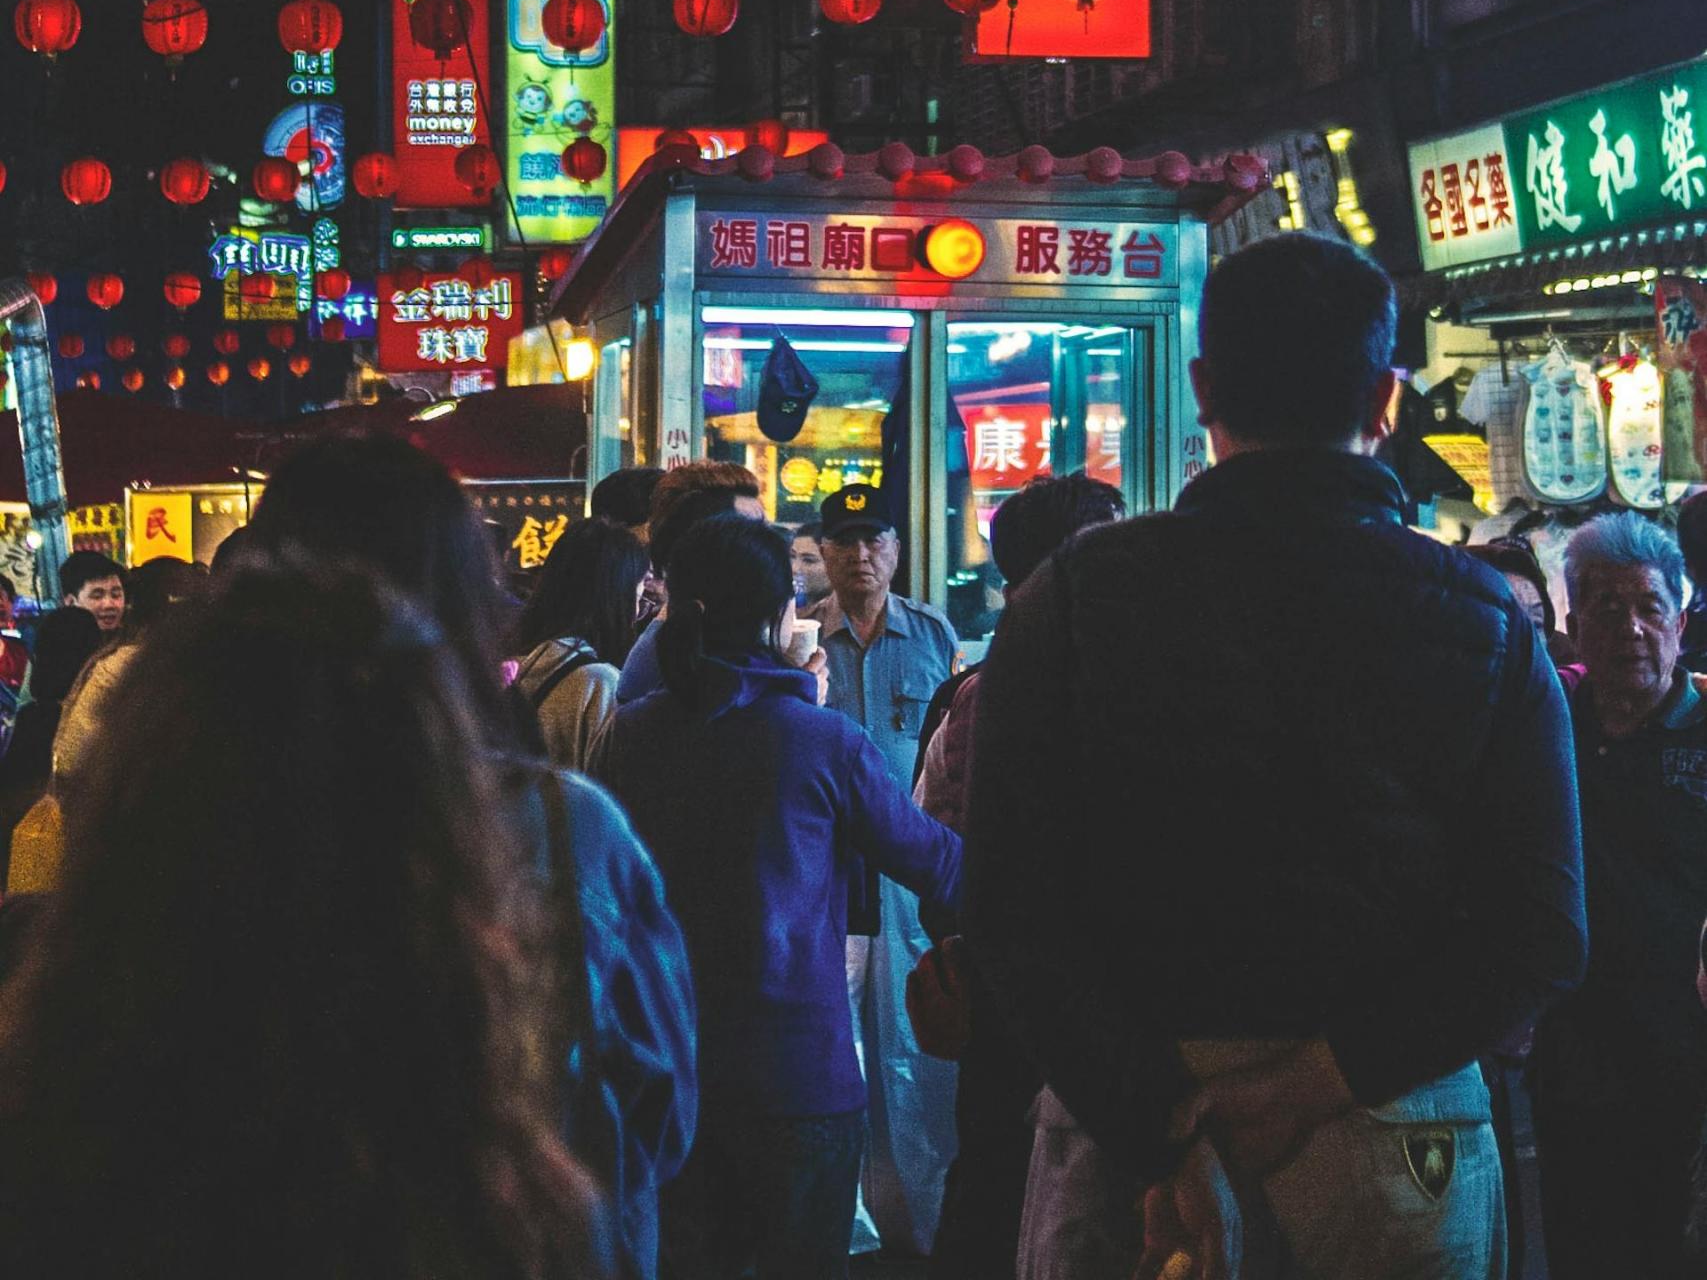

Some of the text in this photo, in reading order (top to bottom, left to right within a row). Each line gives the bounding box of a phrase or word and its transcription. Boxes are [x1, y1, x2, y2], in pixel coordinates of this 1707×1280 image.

[408, 115, 475, 134] money
[1421, 151, 1513, 240] 各國名藥
[710, 219, 1166, 280] 媽祖廟口 服務台
[391, 278, 513, 322] 金瑞利
[417, 325, 489, 364] 珠寶
[1183, 434, 1204, 479] 小心
[145, 507, 176, 543] 民
